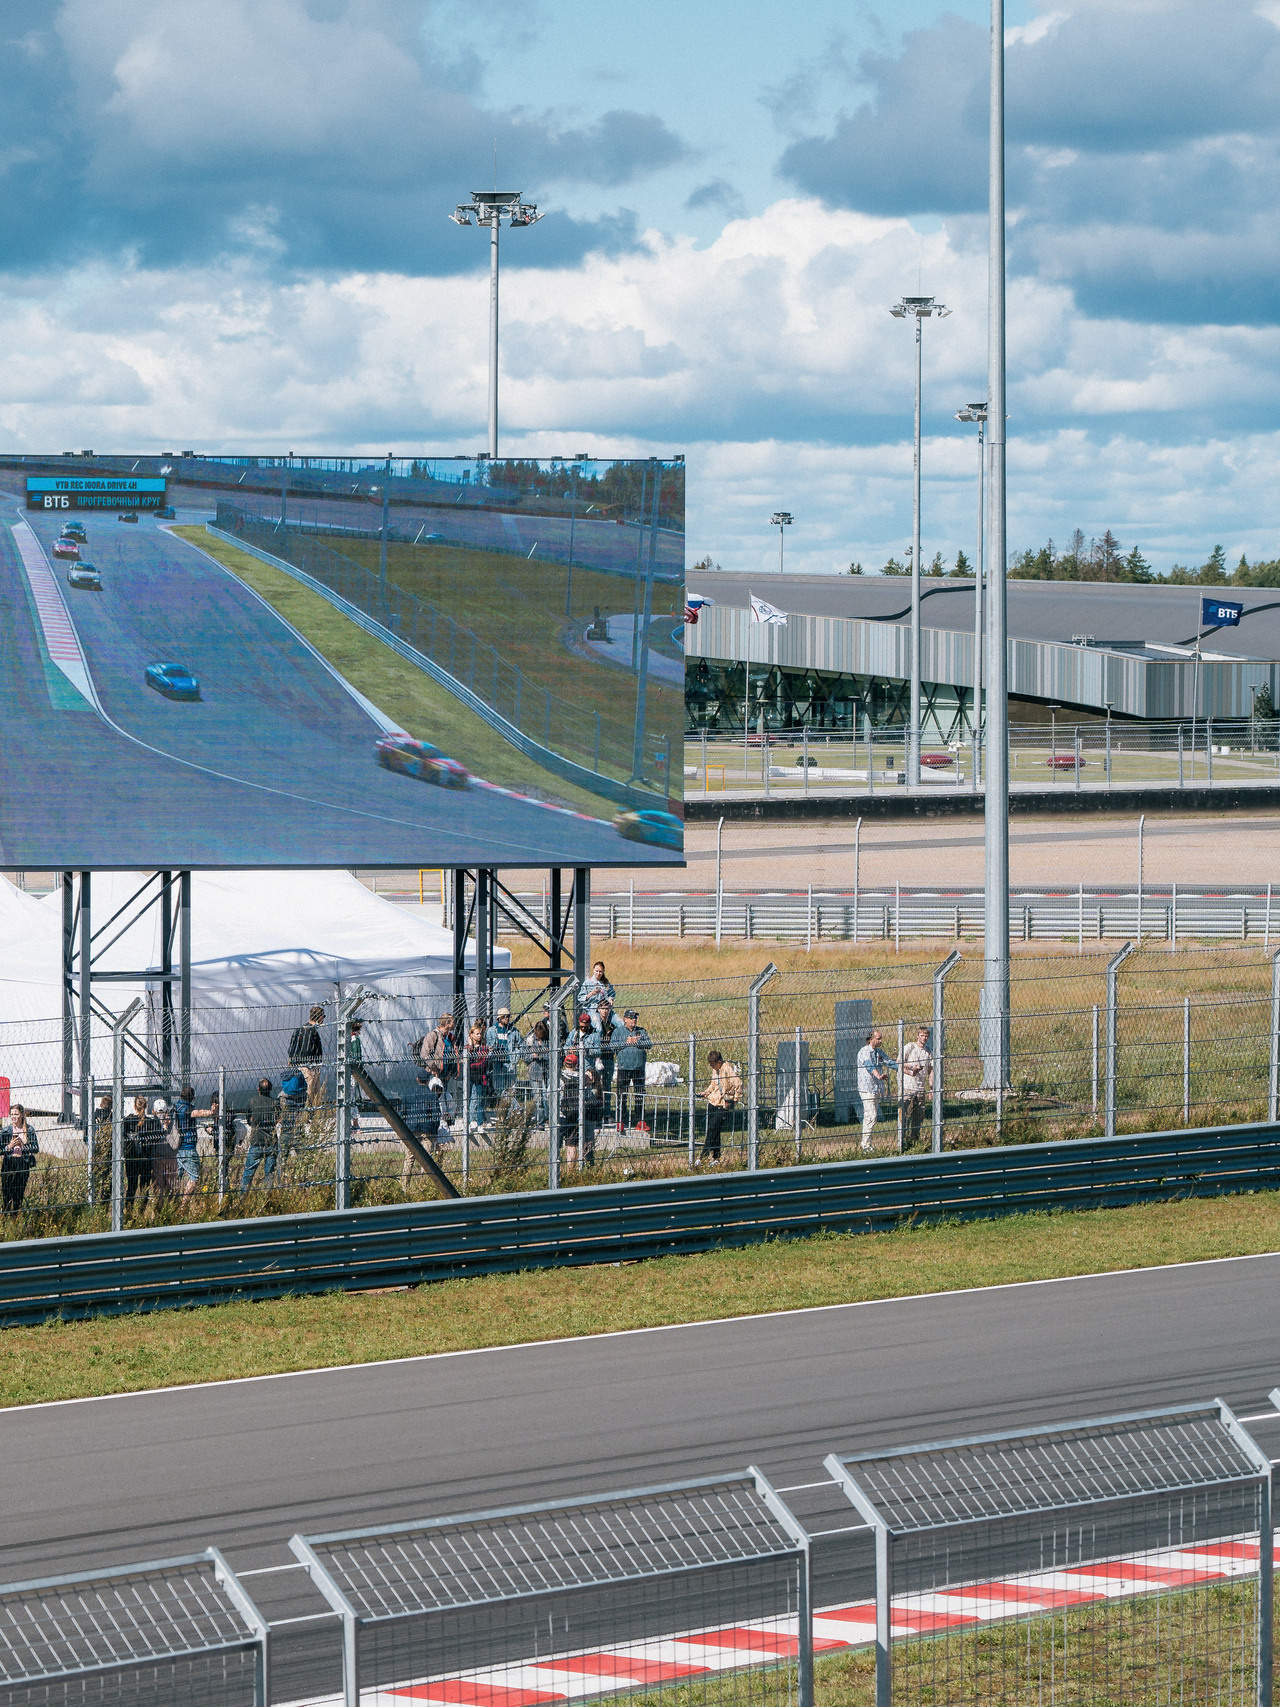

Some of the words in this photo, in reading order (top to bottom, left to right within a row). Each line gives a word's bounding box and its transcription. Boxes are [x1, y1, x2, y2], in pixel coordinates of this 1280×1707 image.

[55, 481, 69, 489] VTB
[70, 481, 84, 489] REC
[85, 481, 106, 489] IGORA
[107, 482, 127, 490] DRIVE
[44, 495, 69, 508] ВТБ
[77, 496, 140, 507] ПРОГРЕВОЧНЫЙ
[141, 496, 161, 506] КРУГ
[1218, 607, 1238, 619] ВТБ
